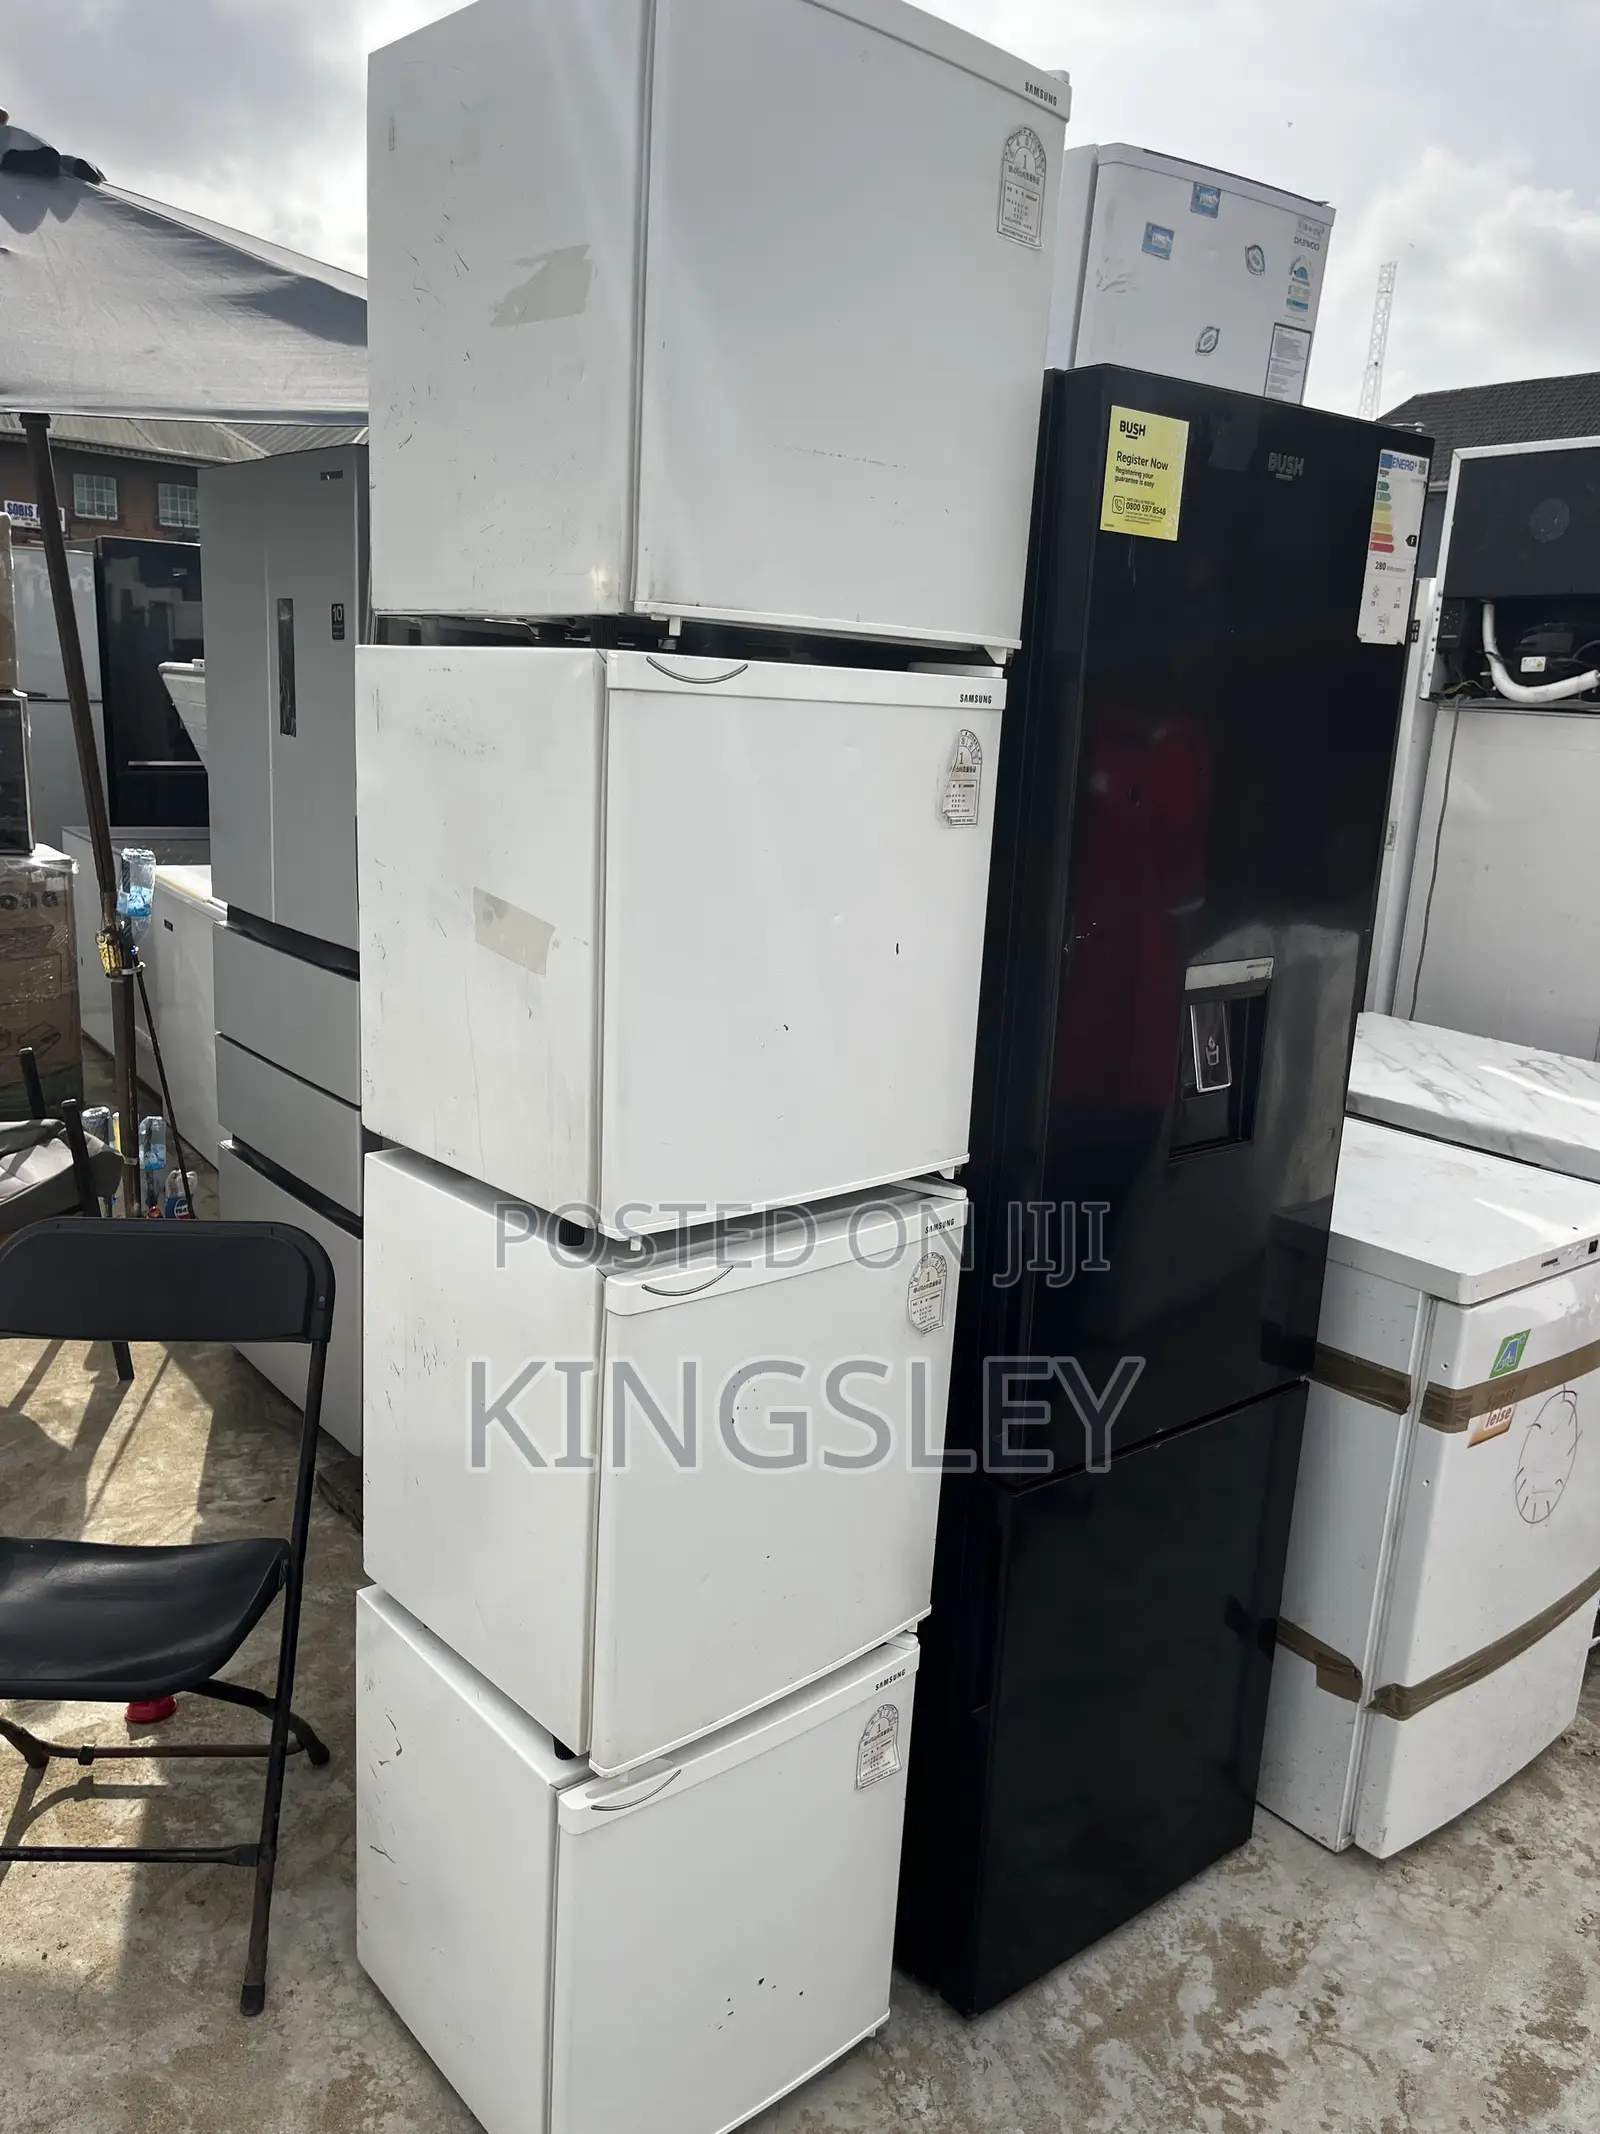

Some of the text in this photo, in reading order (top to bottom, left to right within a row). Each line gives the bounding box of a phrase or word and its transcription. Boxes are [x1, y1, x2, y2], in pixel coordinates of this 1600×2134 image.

[1024, 81, 1058, 107] SAMSUNG
[1293, 236, 1320, 251] DAEWOO
[1119, 420, 1146, 437] BUSH
[1116, 450, 1169, 471] Register Now
[1268, 452, 1304, 477] BUSH
[1115, 466, 1154, 480] Registering your
[1114, 475, 1139, 485] guarantee
[1144, 480, 1155, 489] easy
[7, 502, 33, 517] SOBIS
[1125, 501, 1141, 512] 0800
[1141, 503, 1152, 513] 597
[1152, 505, 1167, 516] 8548
[1375, 561, 1387, 571] 280
[332, 605, 343, 621] 10
[959, 693, 992, 704] SAMSUNG
[925, 1218, 955, 1234] SAMSUNG
[1485, 1405, 1512, 1428] leise
[875, 1668, 906, 1691] SAMSUNG
